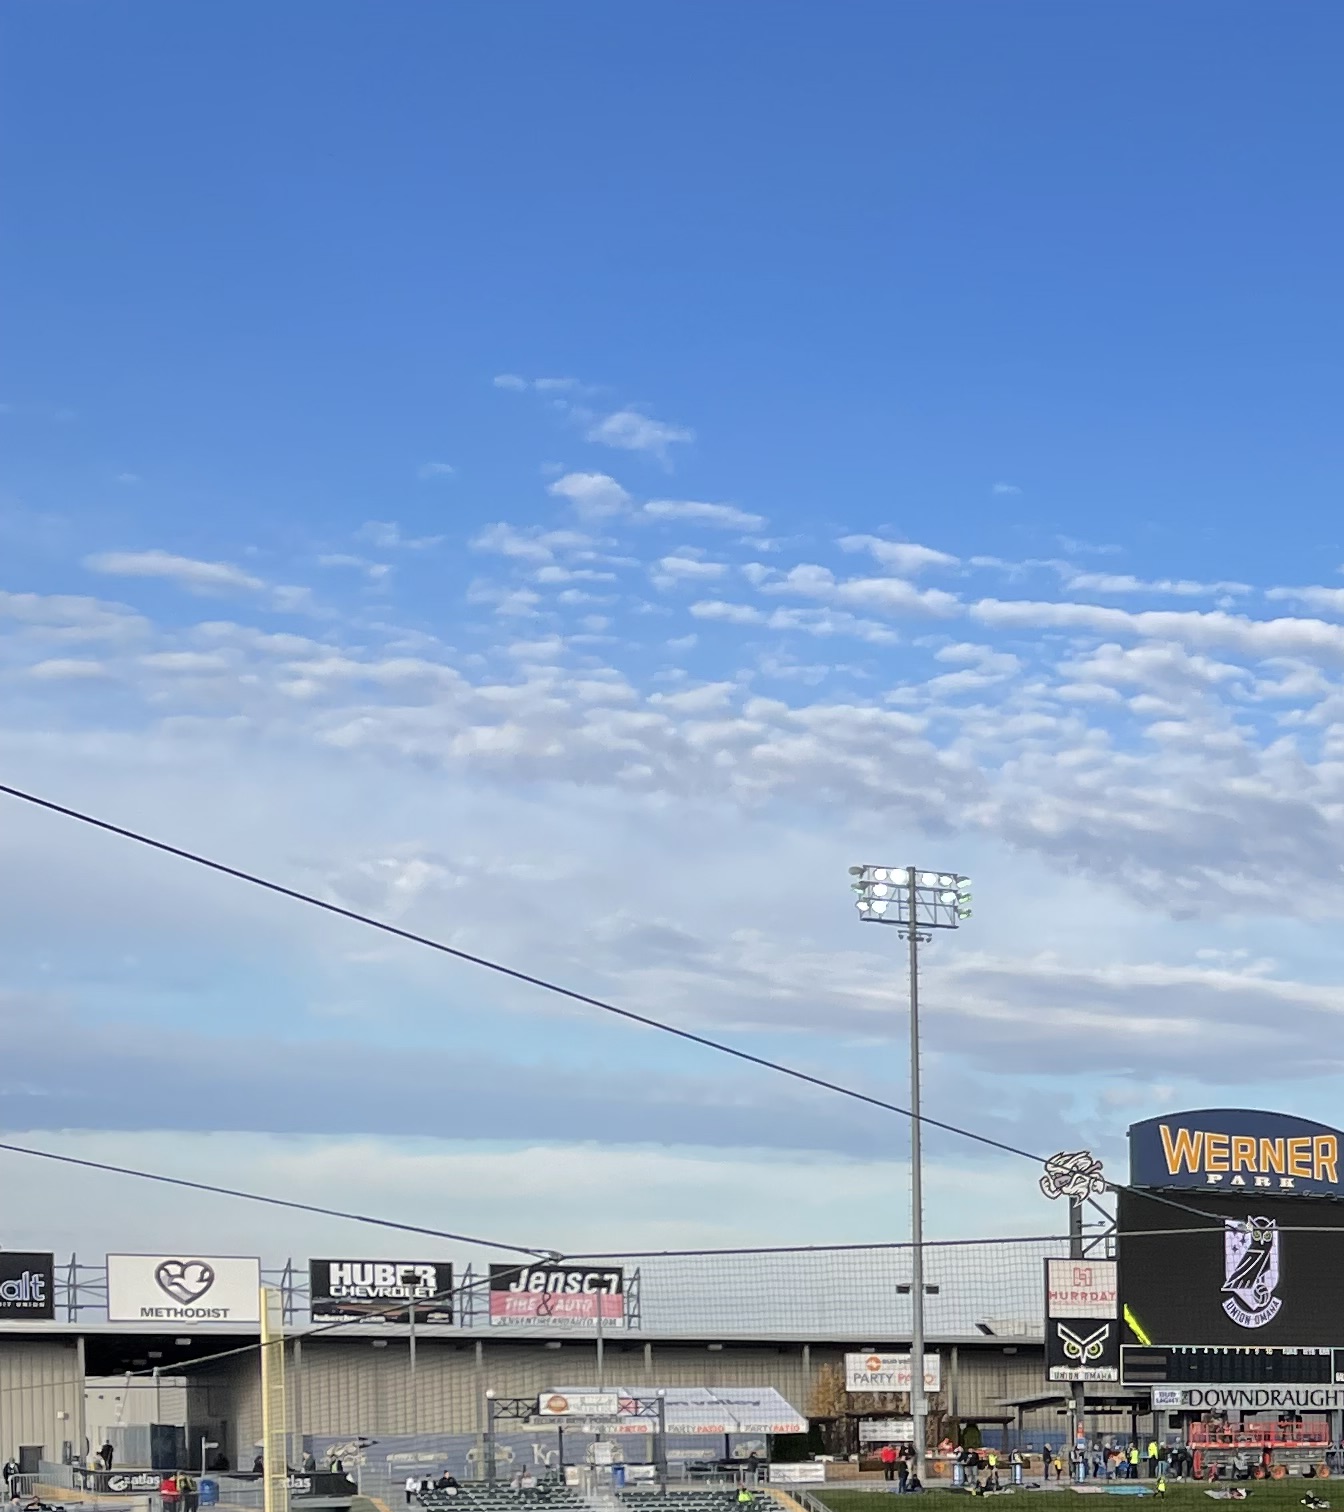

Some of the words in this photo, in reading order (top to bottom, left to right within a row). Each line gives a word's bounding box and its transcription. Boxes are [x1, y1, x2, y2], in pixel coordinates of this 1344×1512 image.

[1159, 1124, 1339, 1183] WERNER
[1206, 1173, 1296, 1188] PARK
[329, 1262, 437, 1286] HUBER
[329, 1286, 438, 1298] CHEVROLET
[1048, 1290, 1117, 1301] HURRDAT
[505, 1297, 537, 1311] TIRE
[556, 1298, 594, 1312] AUTO
[140, 1306, 230, 1319] METHODIST
[1226, 1300, 1252, 1326] UNION
[1254, 1299, 1280, 1325] OMAHA
[853, 1372, 894, 1384] PARTY
[898, 1374, 936, 1386] PAO
[1054, 1371, 1079, 1380] UNION
[1084, 1371, 1112, 1380] OMAHA
[131, 1474, 160, 1486] atlas
